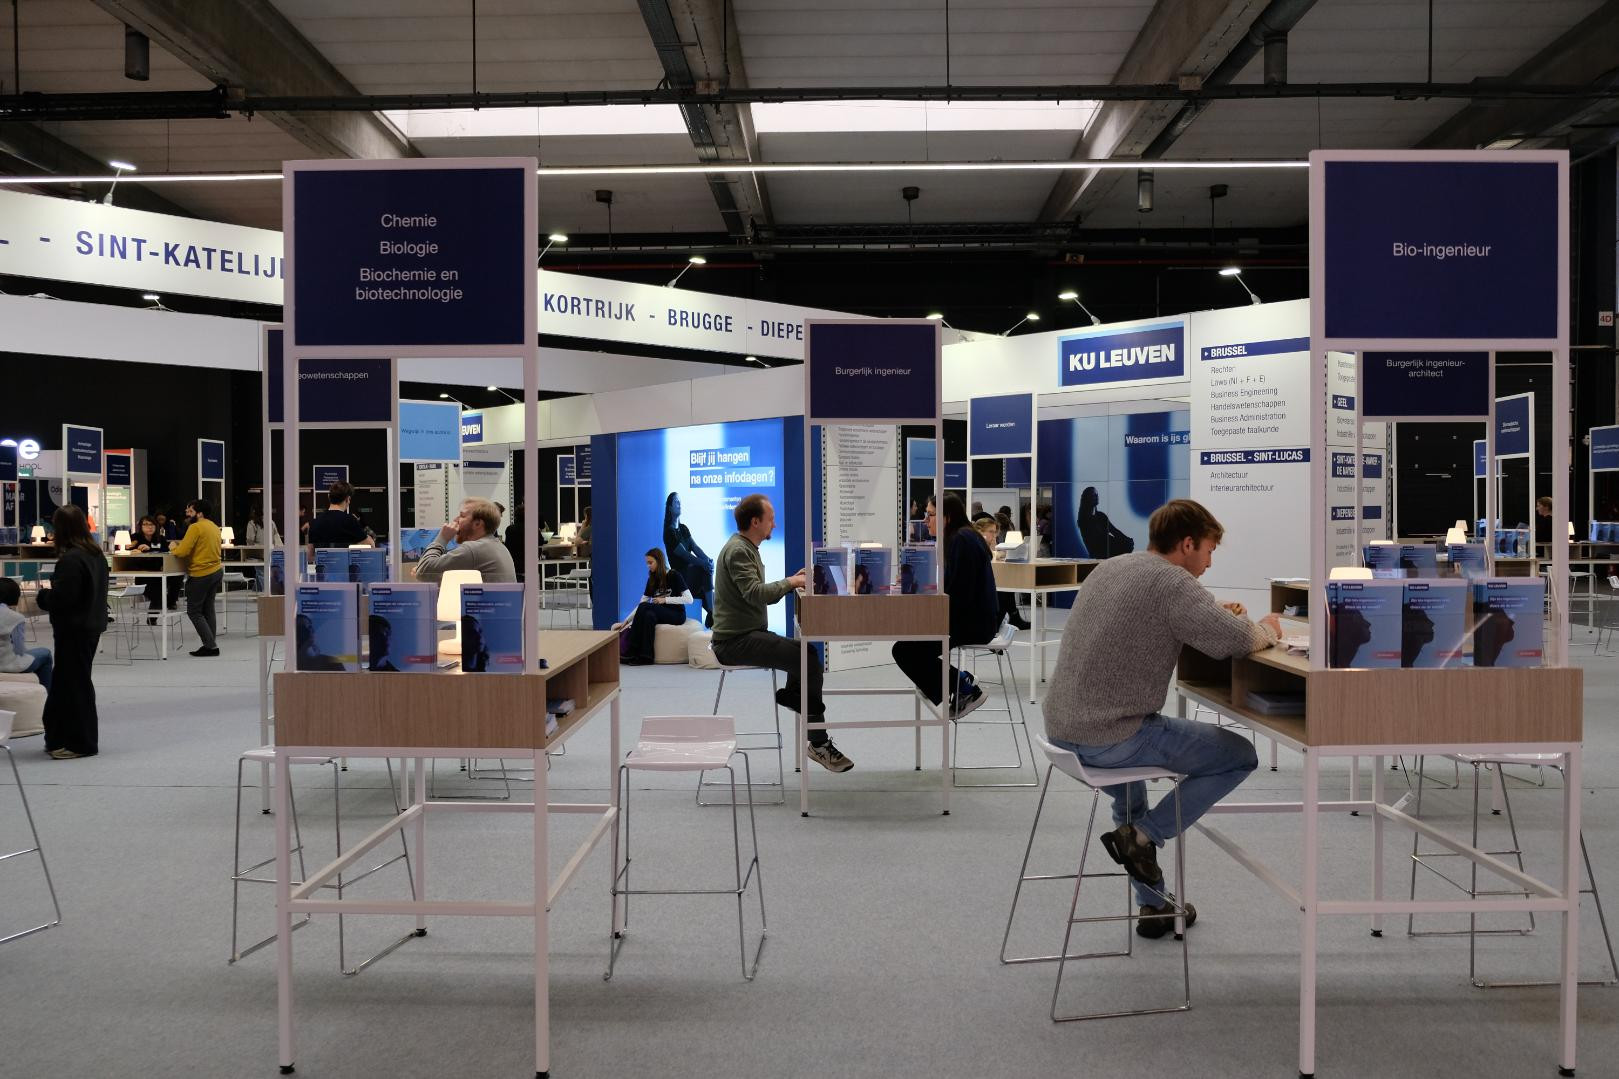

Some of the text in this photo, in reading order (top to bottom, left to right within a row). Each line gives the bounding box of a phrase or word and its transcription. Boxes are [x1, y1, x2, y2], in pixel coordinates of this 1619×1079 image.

[381, 213, 437, 228] Chemie
[76, 230, 284, 279] SINT-KATELIJ
[380, 240, 438, 257] Biologie
[1393, 242, 1491, 260] Bio-ingenieur
[360, 268, 459, 281] Biochemie en
[355, 286, 463, 303] biotechnologie
[544, 293, 636, 322] KORTRIJK
[668, 308, 733, 333] BRUGGE
[761, 320, 803, 341] DIEPE
[1069, 343, 1175, 372] KU LEUVEN
[1210, 345, 1247, 358] BRUSSEL
[1386, 359, 1424, 369] Burgerlijk
[298, 371, 369, 380] eowetenschappen
[835, 366, 911, 377] Burgerlijk ingenieur
[1408, 369, 1443, 377] architect
[1210, 387, 1278, 399] Business Engineering
[1210, 399, 1286, 411] Handelswetenschappen
[1210, 412, 1286, 424] Business Administration
[461, 423, 481, 436] EUVEN
[1125, 433, 1190, 444] Waarom is ijs g
[690, 451, 749, 466] Blijf jij hangen
[1210, 452, 1246, 463] BRUSSEL
[1253, 450, 1303, 461] SINT-LUCAS
[690, 475, 701, 485] na
[702, 474, 723, 484] onze
[1210, 471, 1249, 479] Architectuur
